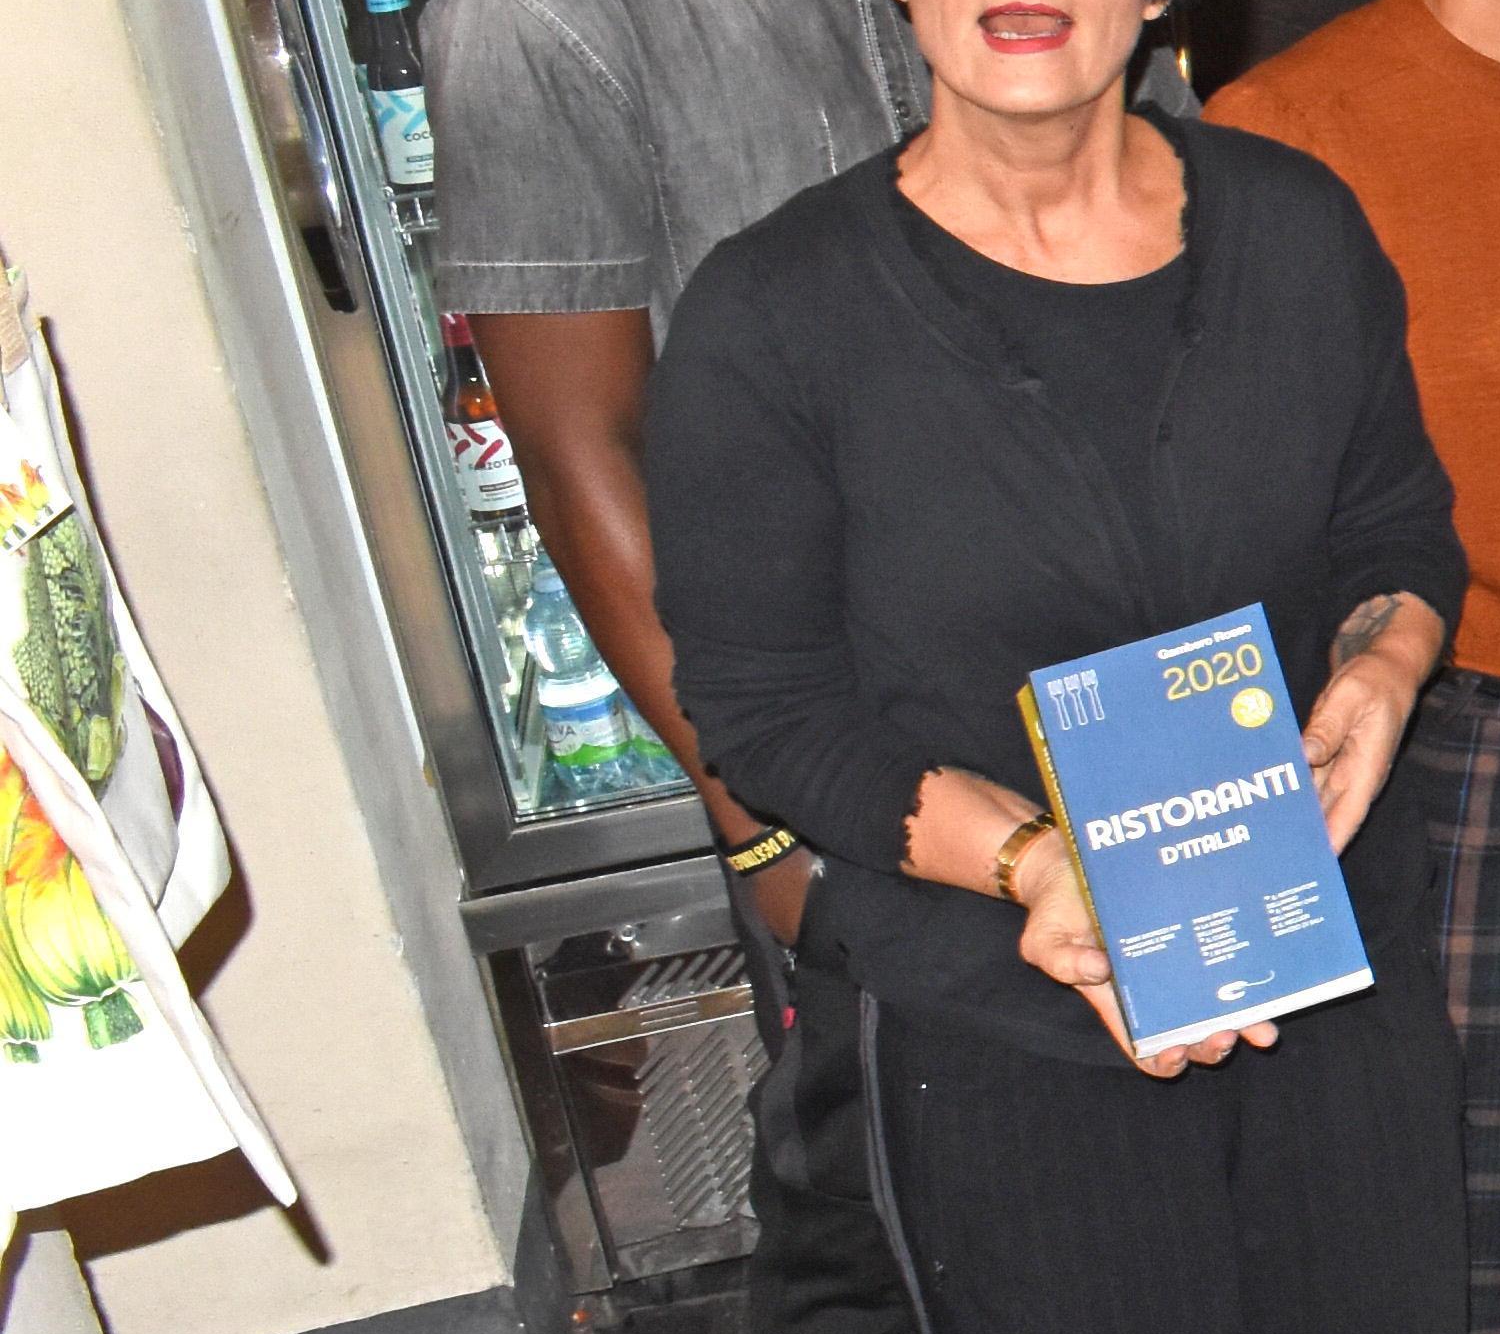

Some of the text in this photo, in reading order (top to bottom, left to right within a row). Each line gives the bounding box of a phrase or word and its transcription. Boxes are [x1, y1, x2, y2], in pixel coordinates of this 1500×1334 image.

[1163, 642, 1263, 701] 2020
[1085, 762, 1301, 851] RISTORANTI
[1159, 824, 1250, 866] D'ITALIA
